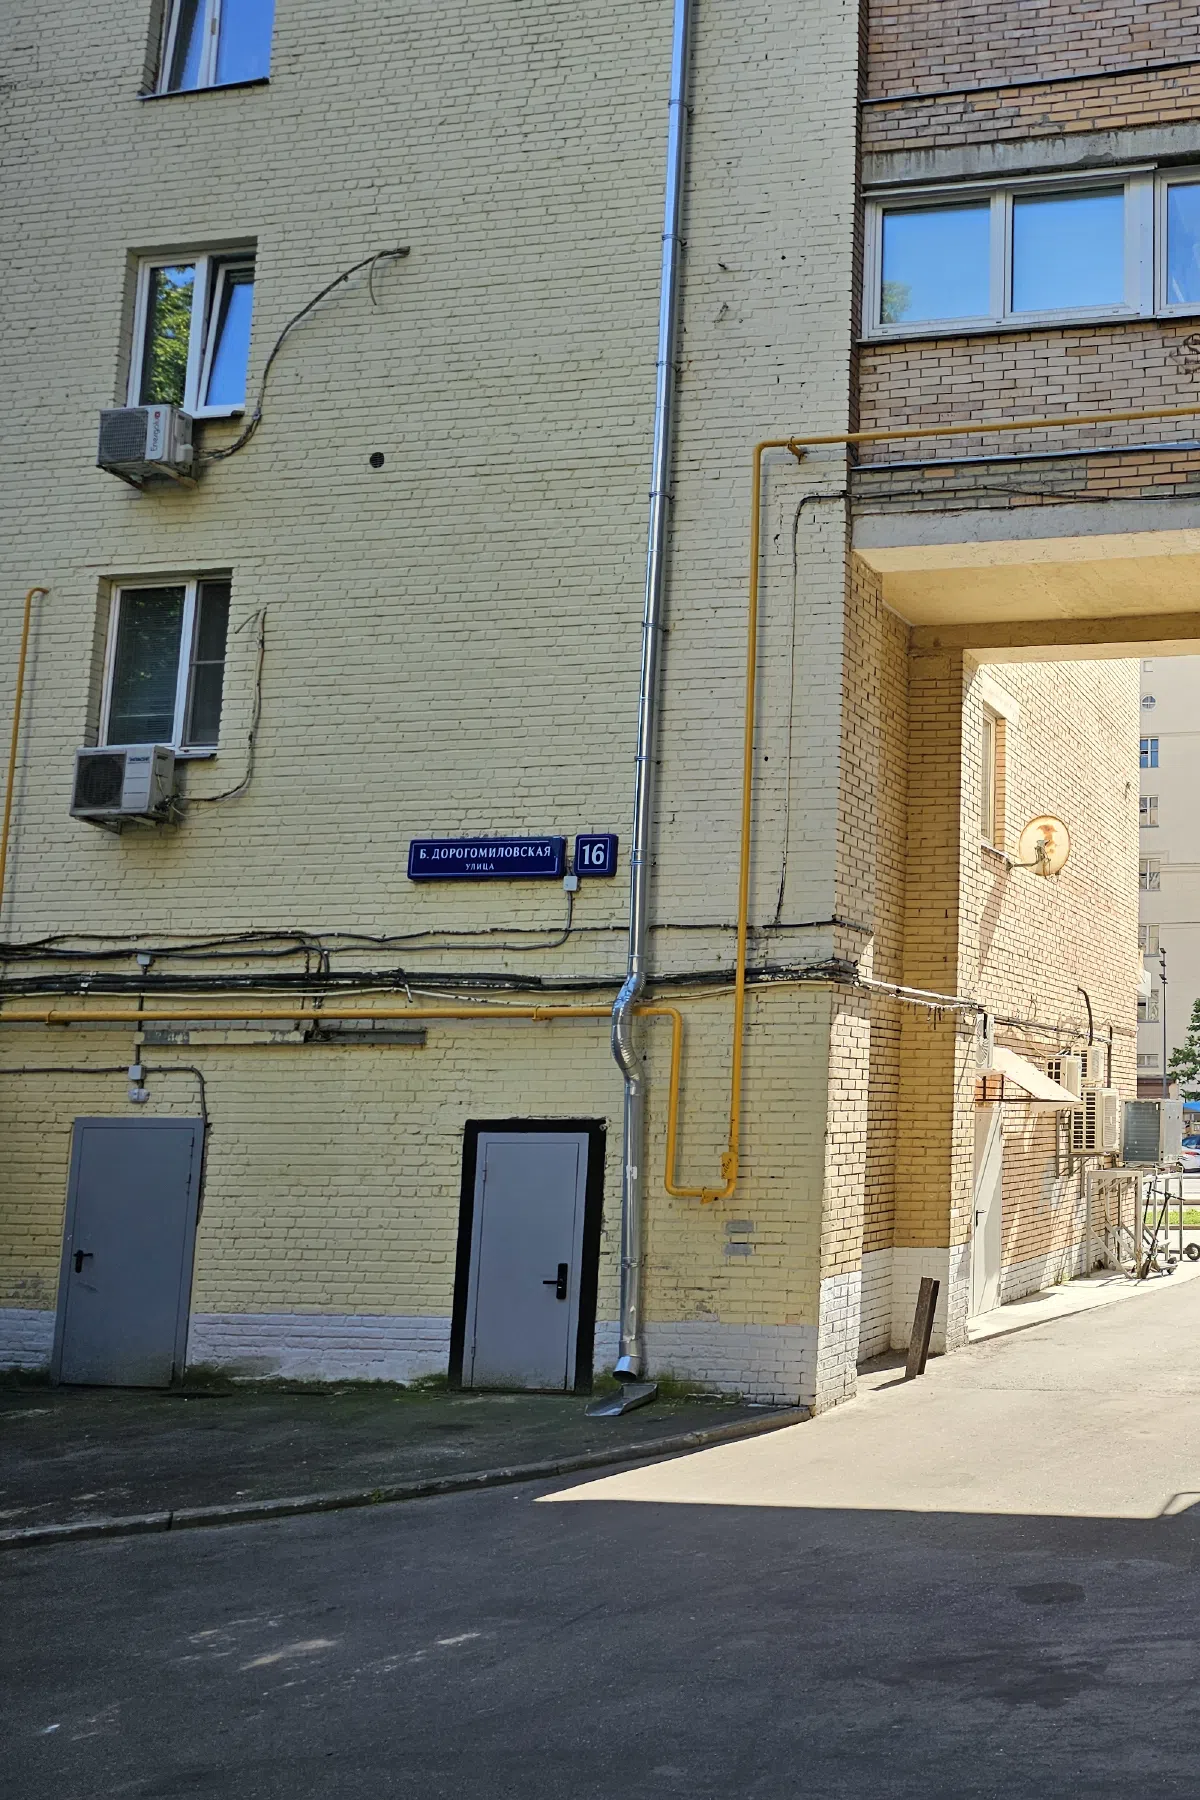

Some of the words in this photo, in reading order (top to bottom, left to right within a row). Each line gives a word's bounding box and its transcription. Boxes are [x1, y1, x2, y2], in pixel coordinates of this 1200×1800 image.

[419, 848, 430, 859] Б.
[432, 846, 551, 860] ДОРОГОМИЛОВСКАЯ
[581, 843, 605, 865] 16
[465, 863, 495, 871] УЛИЦА
